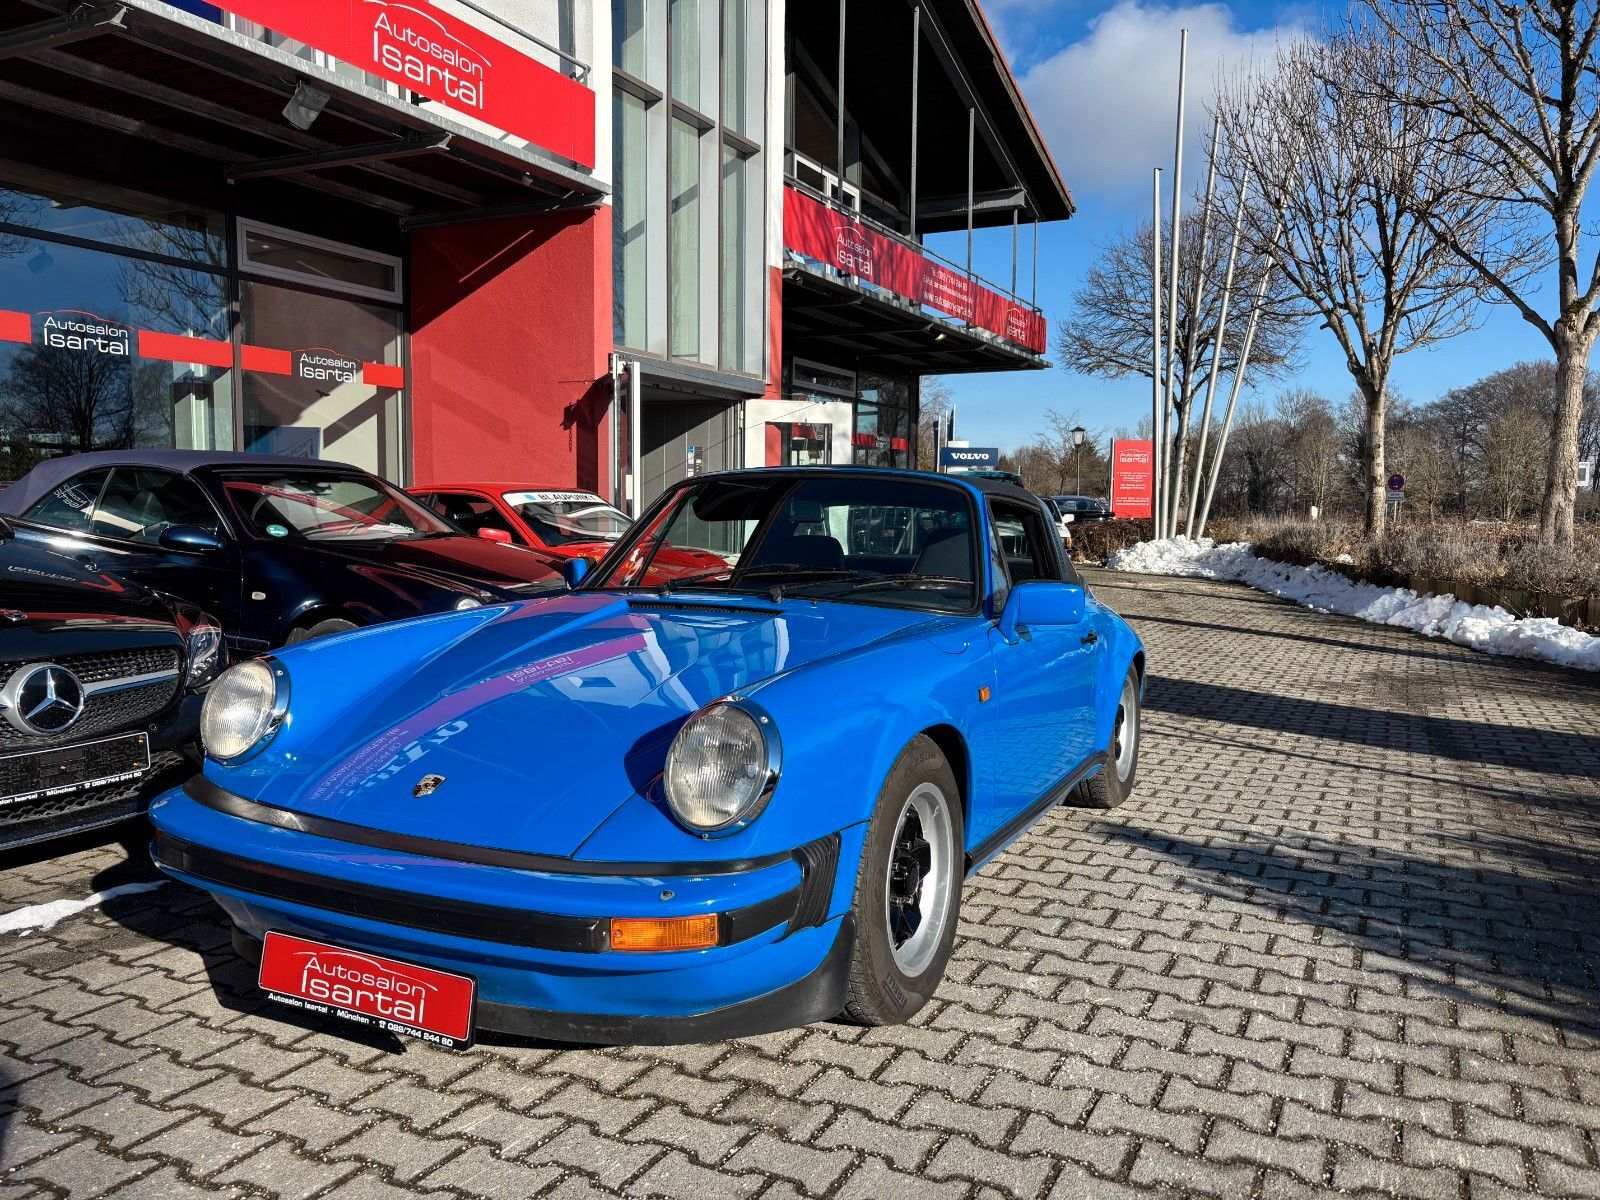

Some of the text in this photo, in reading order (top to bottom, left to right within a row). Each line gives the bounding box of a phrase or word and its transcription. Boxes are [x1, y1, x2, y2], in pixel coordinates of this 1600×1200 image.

[375, 12, 483, 79] Autosalon
[373, 30, 484, 109] Isartal
[837, 232, 873, 258] Autosalon
[836, 243, 873, 277] Isartal
[44, 316, 129, 338] Autosalon
[44, 327, 129, 356] Isartal
[300, 353, 357, 369] Autosalon
[300, 362, 357, 384] Isartal
[951, 452, 989, 460] VOLVO
[538, 493, 596, 501] BLAUPUNKT
[15, 793, 38, 802] Isartal
[47, 785, 77, 797] München
[304, 956, 426, 999] Autosalon
[301, 969, 426, 1024] Isartal
[268, 992, 454, 1047] Autosalon Isartal München 089/744 244 60
